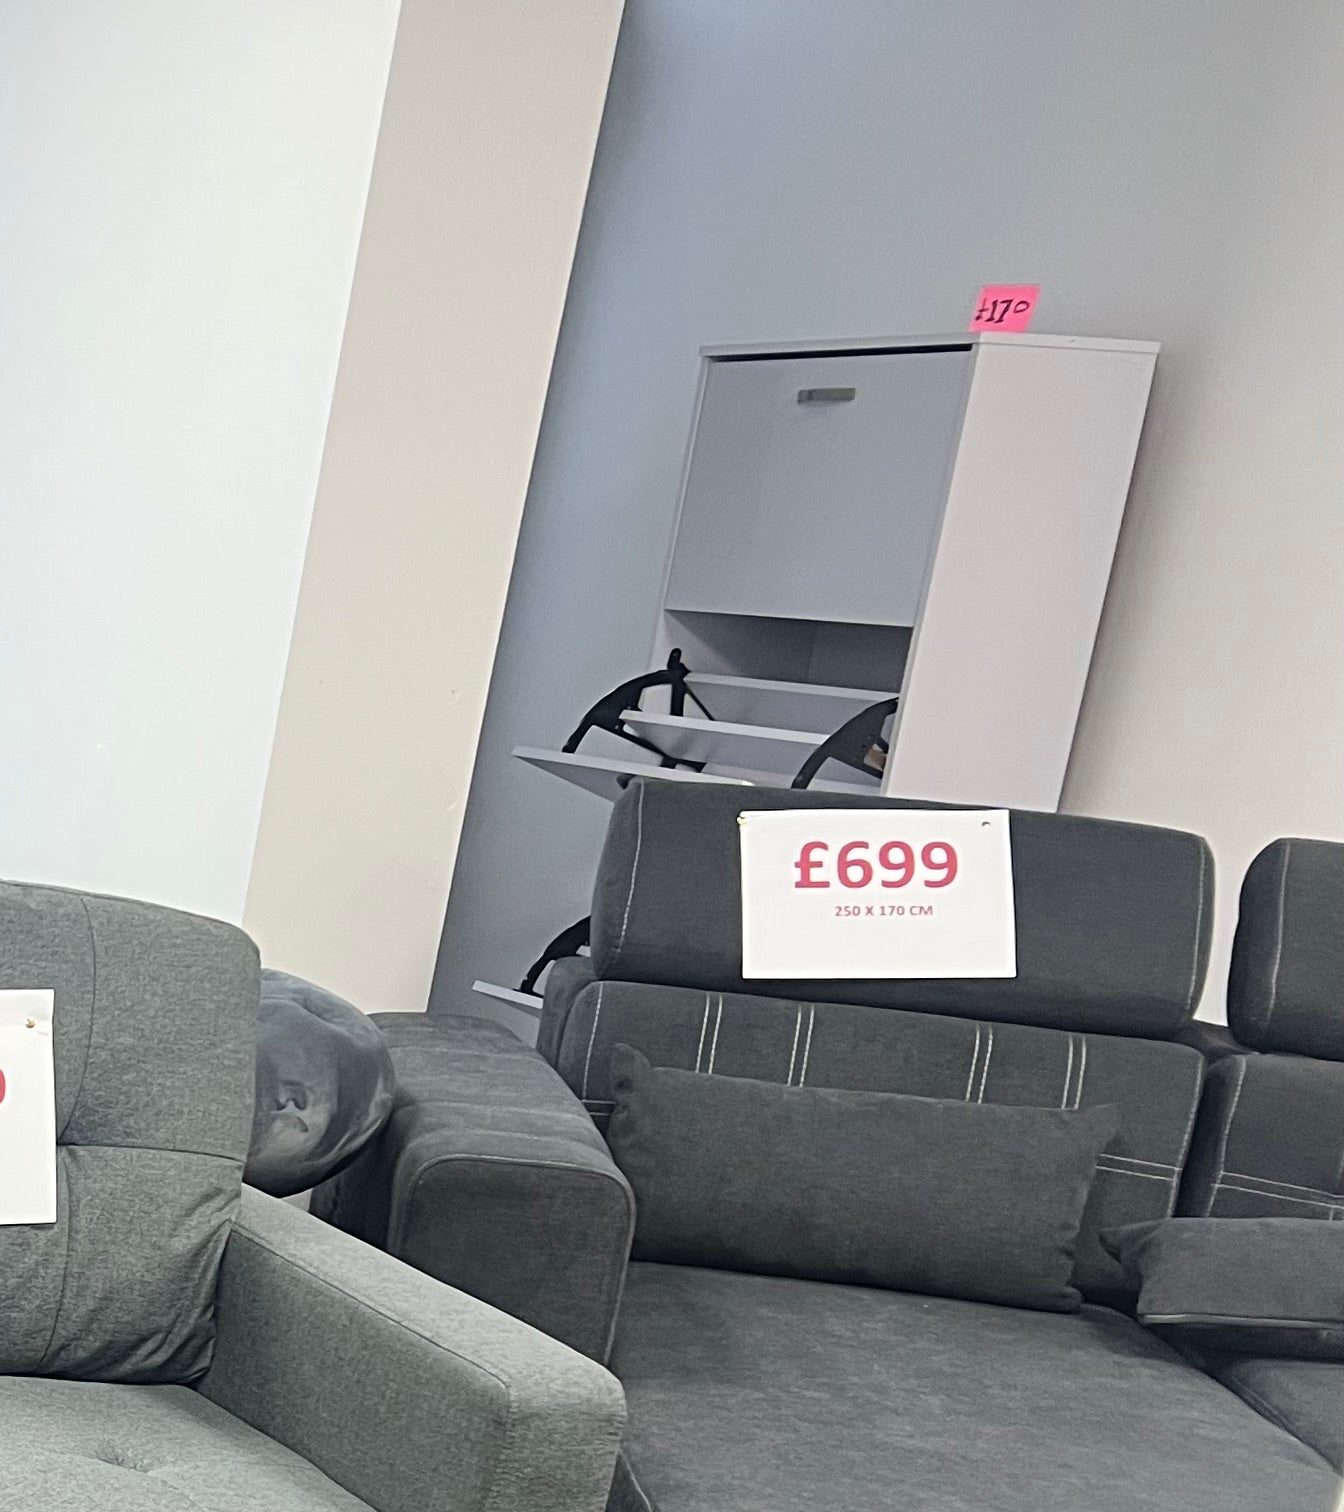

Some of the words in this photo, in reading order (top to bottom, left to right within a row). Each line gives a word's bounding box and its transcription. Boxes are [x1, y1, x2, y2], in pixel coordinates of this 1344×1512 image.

[795, 841, 959, 889] £699
[834, 904, 861, 917] 250
[865, 905, 875, 917] X
[878, 904, 905, 917] 170
[909, 904, 934, 917] CM
